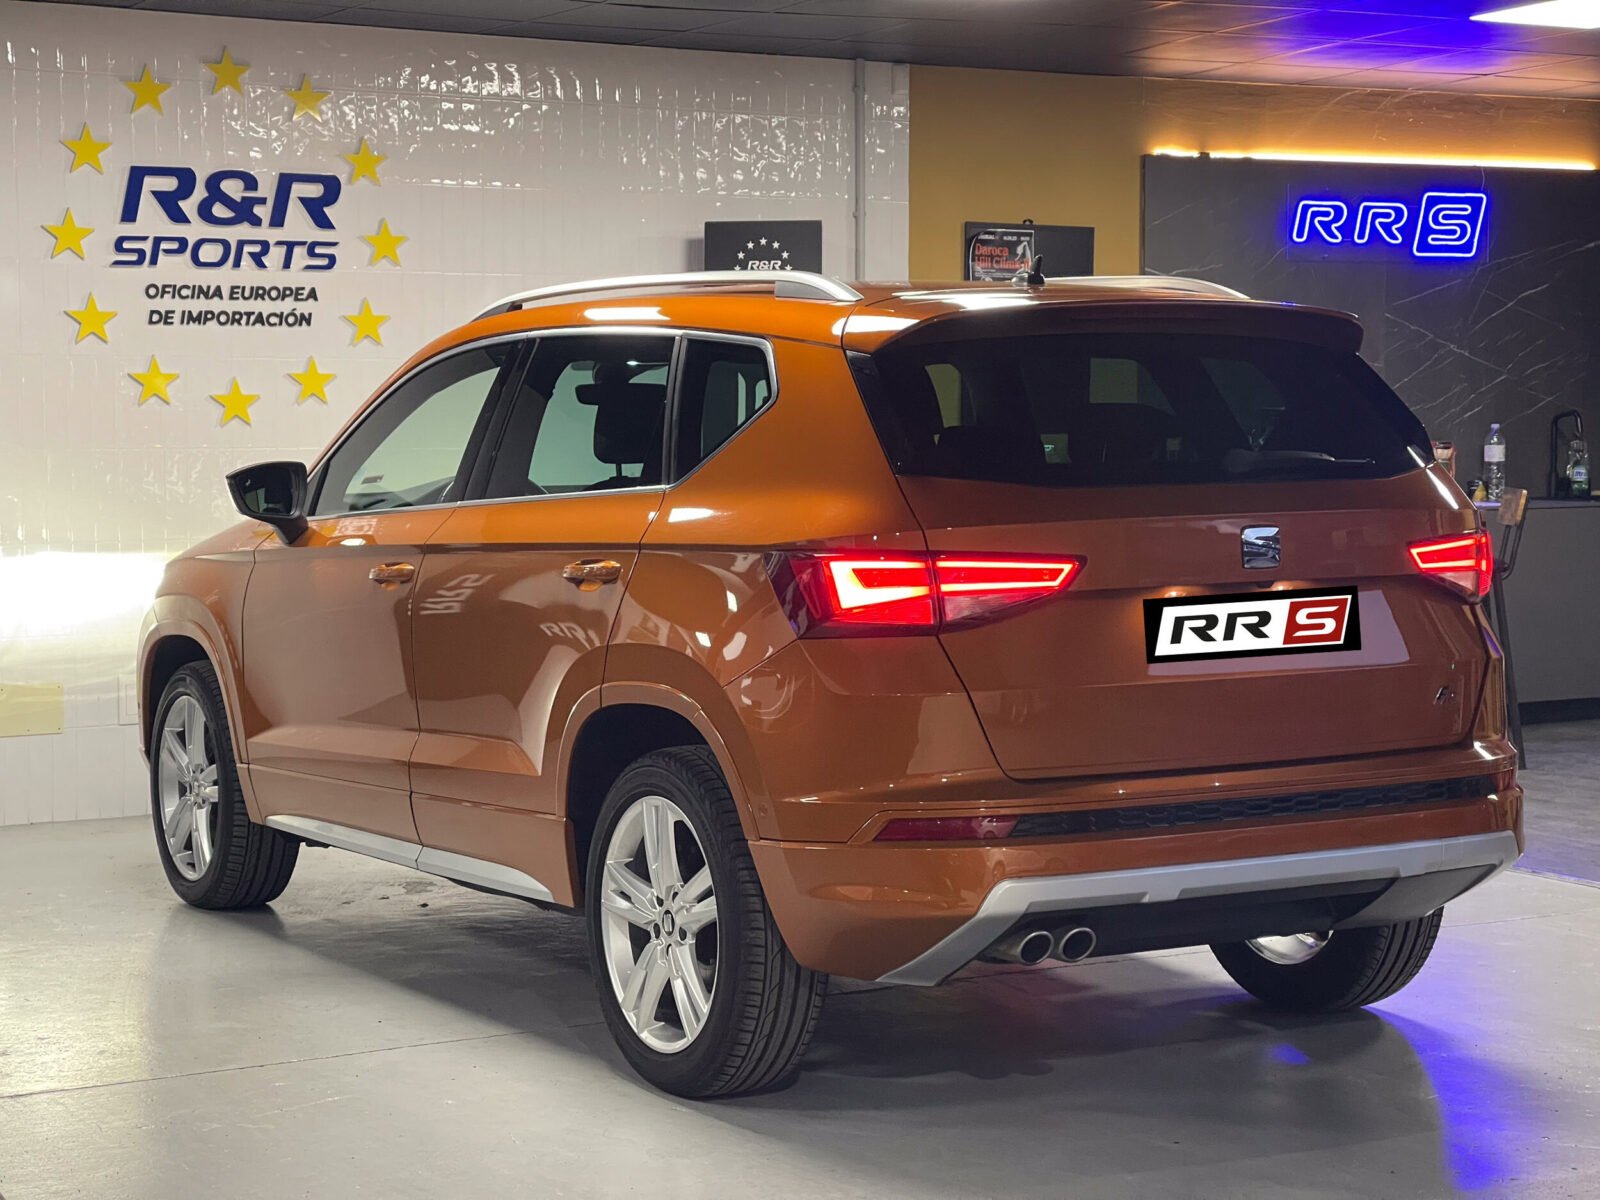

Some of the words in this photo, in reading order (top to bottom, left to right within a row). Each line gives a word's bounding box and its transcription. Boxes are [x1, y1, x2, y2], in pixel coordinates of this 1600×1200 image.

[120, 165, 342, 230] R&R
[111, 235, 340, 271] SPORTS
[975, 243, 1009, 256] Daroca
[747, 260, 782, 271] R&R
[145, 283, 224, 302] OFICINA
[228, 285, 319, 302] EUROPEA
[148, 309, 175, 326] DE
[180, 307, 312, 327] IMPORTACIÓN
